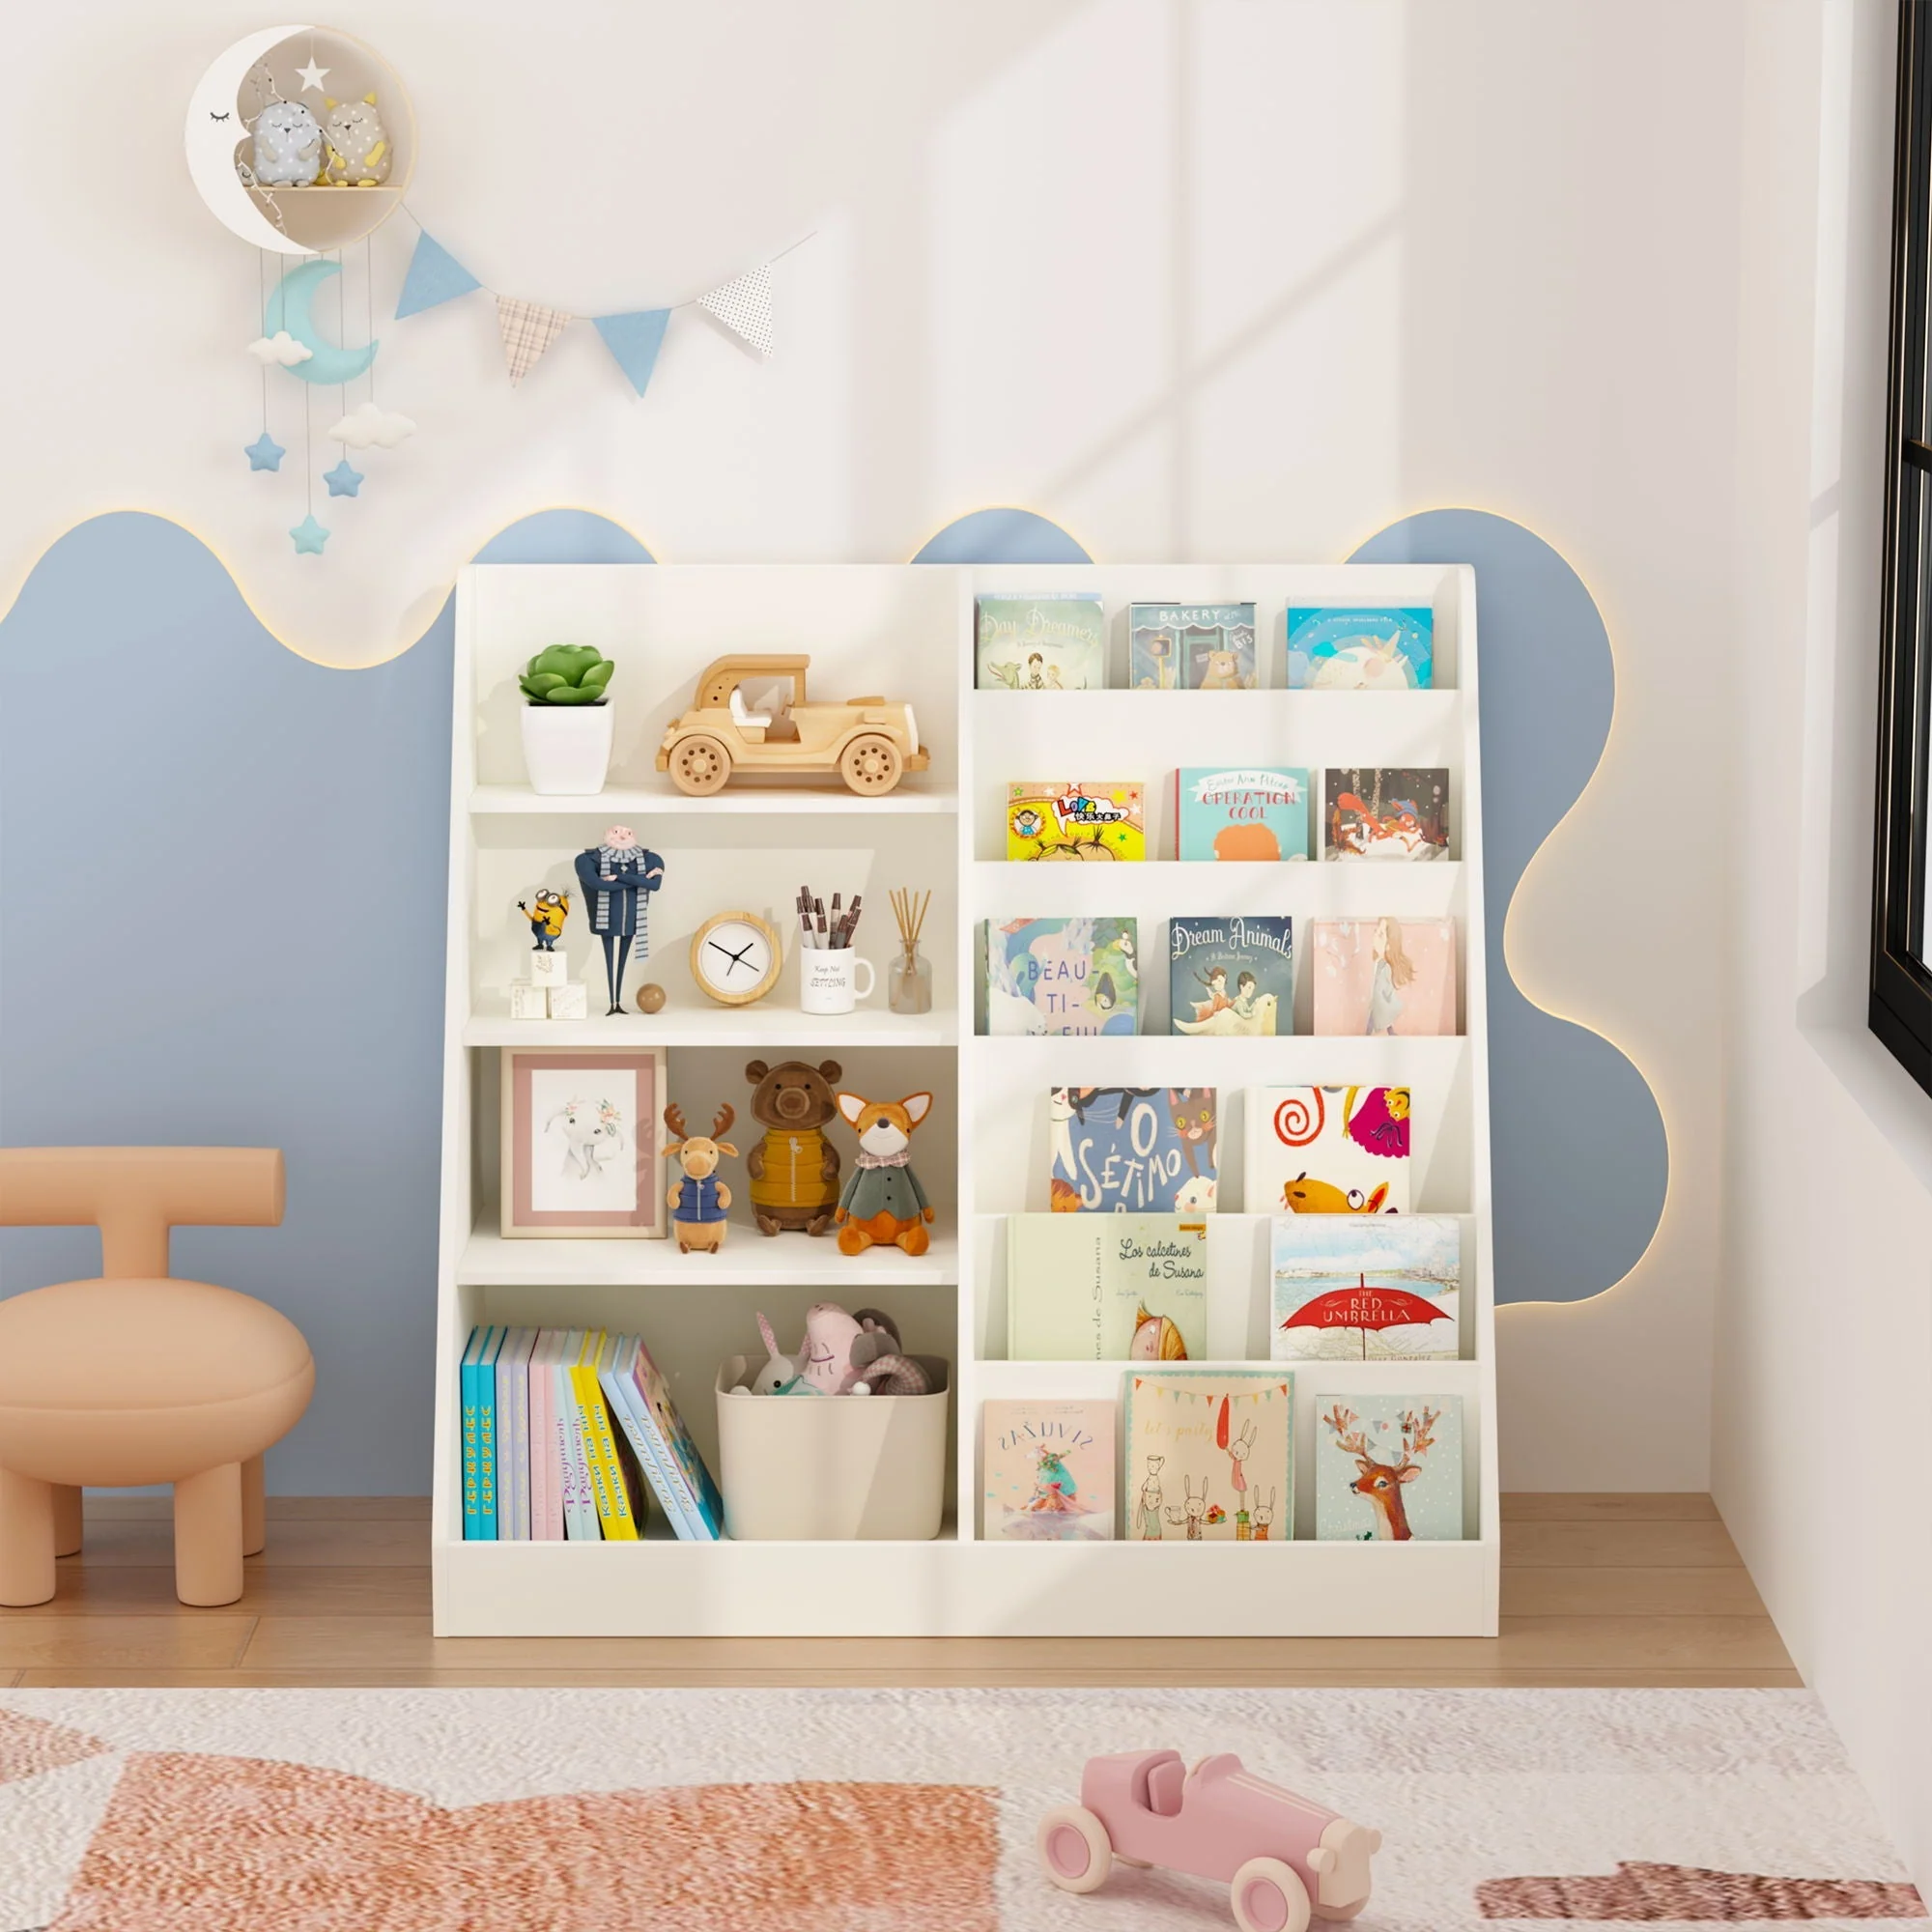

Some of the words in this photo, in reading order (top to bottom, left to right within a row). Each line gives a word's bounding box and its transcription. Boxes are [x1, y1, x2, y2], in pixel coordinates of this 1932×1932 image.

[1159, 610, 1221, 621] BAKERY
[1202, 792, 1295, 805] OPERATION
[1229, 807, 1267, 819] COOL
[1171, 922, 1226, 960] Dream
[1228, 917, 1292, 959] Animals
[1028, 960, 1099, 980] BEAU-
[1046, 993, 1080, 1013] TI-
[1130, 1102, 1158, 1157] O
[1119, 1237, 1143, 1260] Los
[1146, 1240, 1191, 1258] calcetines
[1149, 1262, 1161, 1278] de
[1162, 1260, 1204, 1279] Susana
[1350, 1297, 1382, 1310] RED
[1323, 1309, 1410, 1324] UMBRELLA
[466, 1405, 477, 1515] ГЕРКУЛЕС
[481, 1405, 493, 1515] ГЕРКУЛЕС
[585, 1437, 597, 1460] на
[602, 1437, 613, 1460] на
[592, 1465, 611, 1517] Казки
[609, 1465, 627, 1517] Казки
